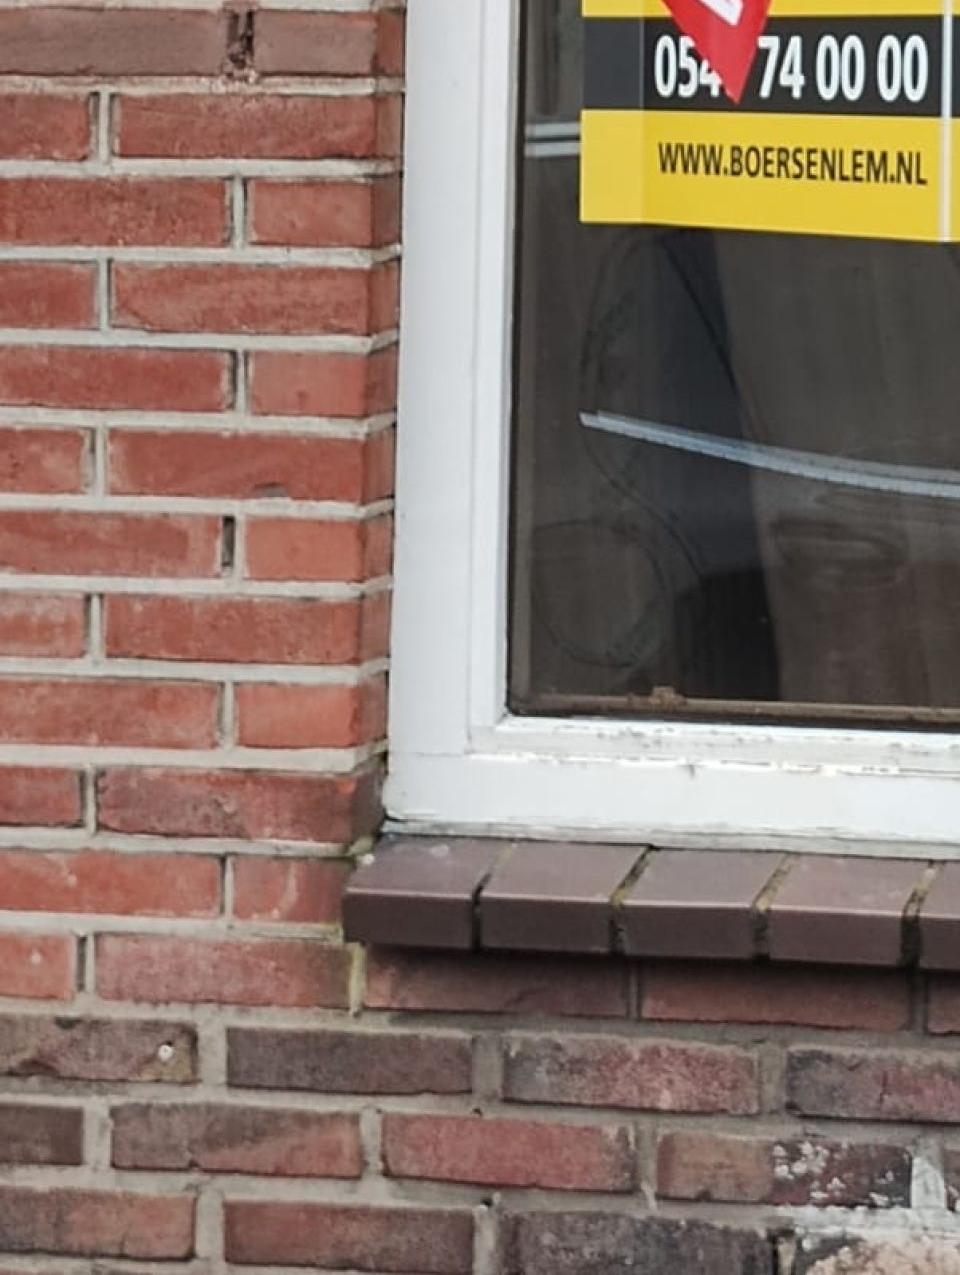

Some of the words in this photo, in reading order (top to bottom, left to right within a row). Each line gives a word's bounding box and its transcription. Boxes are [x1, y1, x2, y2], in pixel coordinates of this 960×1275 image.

[654, 34, 724, 98] 054
[757, 35, 806, 99] 74
[816, 34, 865, 102] 00
[876, 34, 929, 103] 00
[658, 142, 928, 185] WWW.BOERSENLEM.NL
